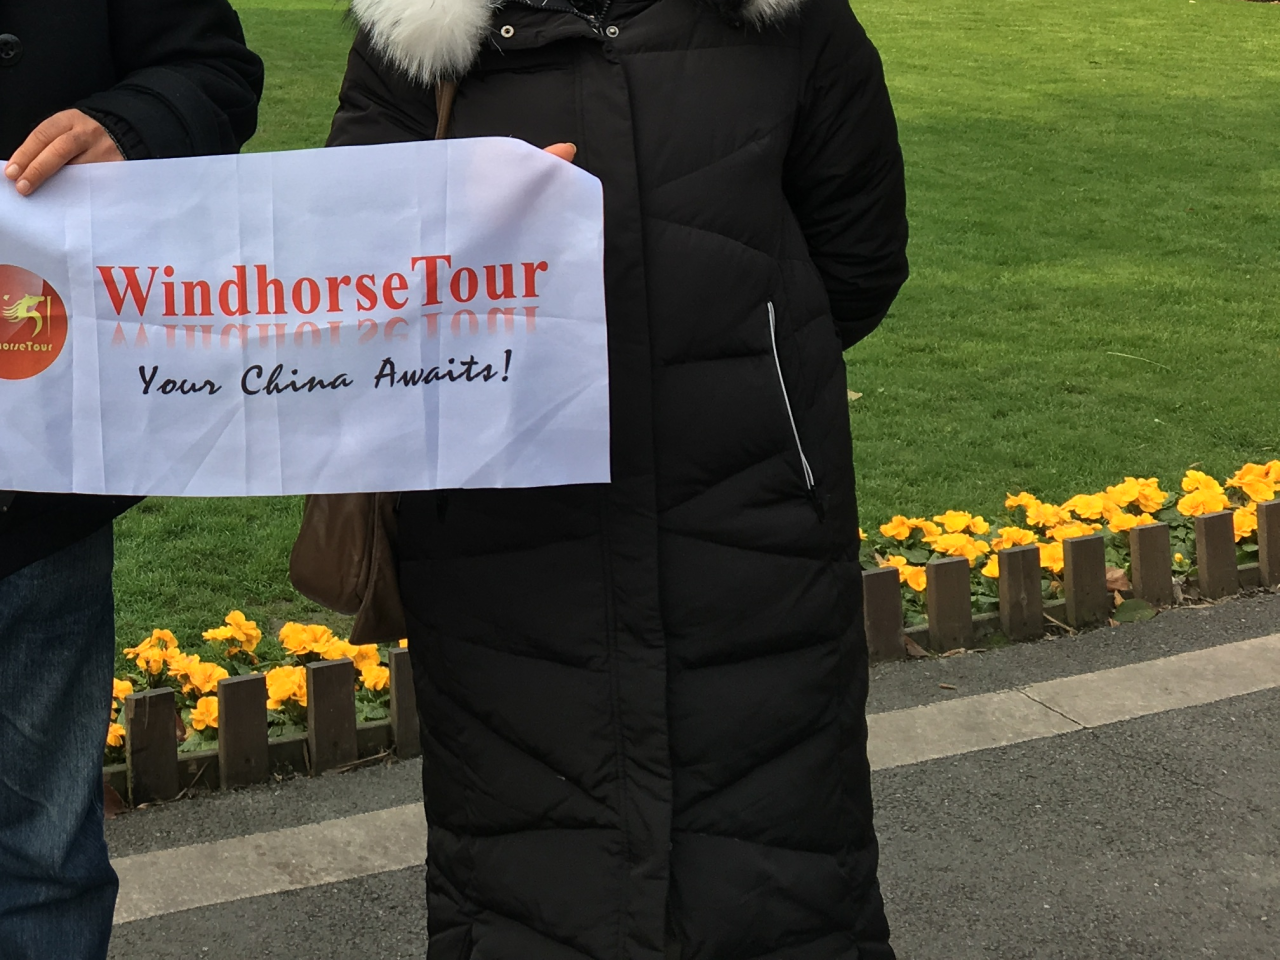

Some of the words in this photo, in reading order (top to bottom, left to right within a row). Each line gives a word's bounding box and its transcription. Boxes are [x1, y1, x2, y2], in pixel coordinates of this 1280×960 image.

[96, 254, 549, 318] WindhorseTour
[138, 365, 223, 396] Your
[240, 363, 354, 396] China
[374, 348, 513, 390] Awaits!
